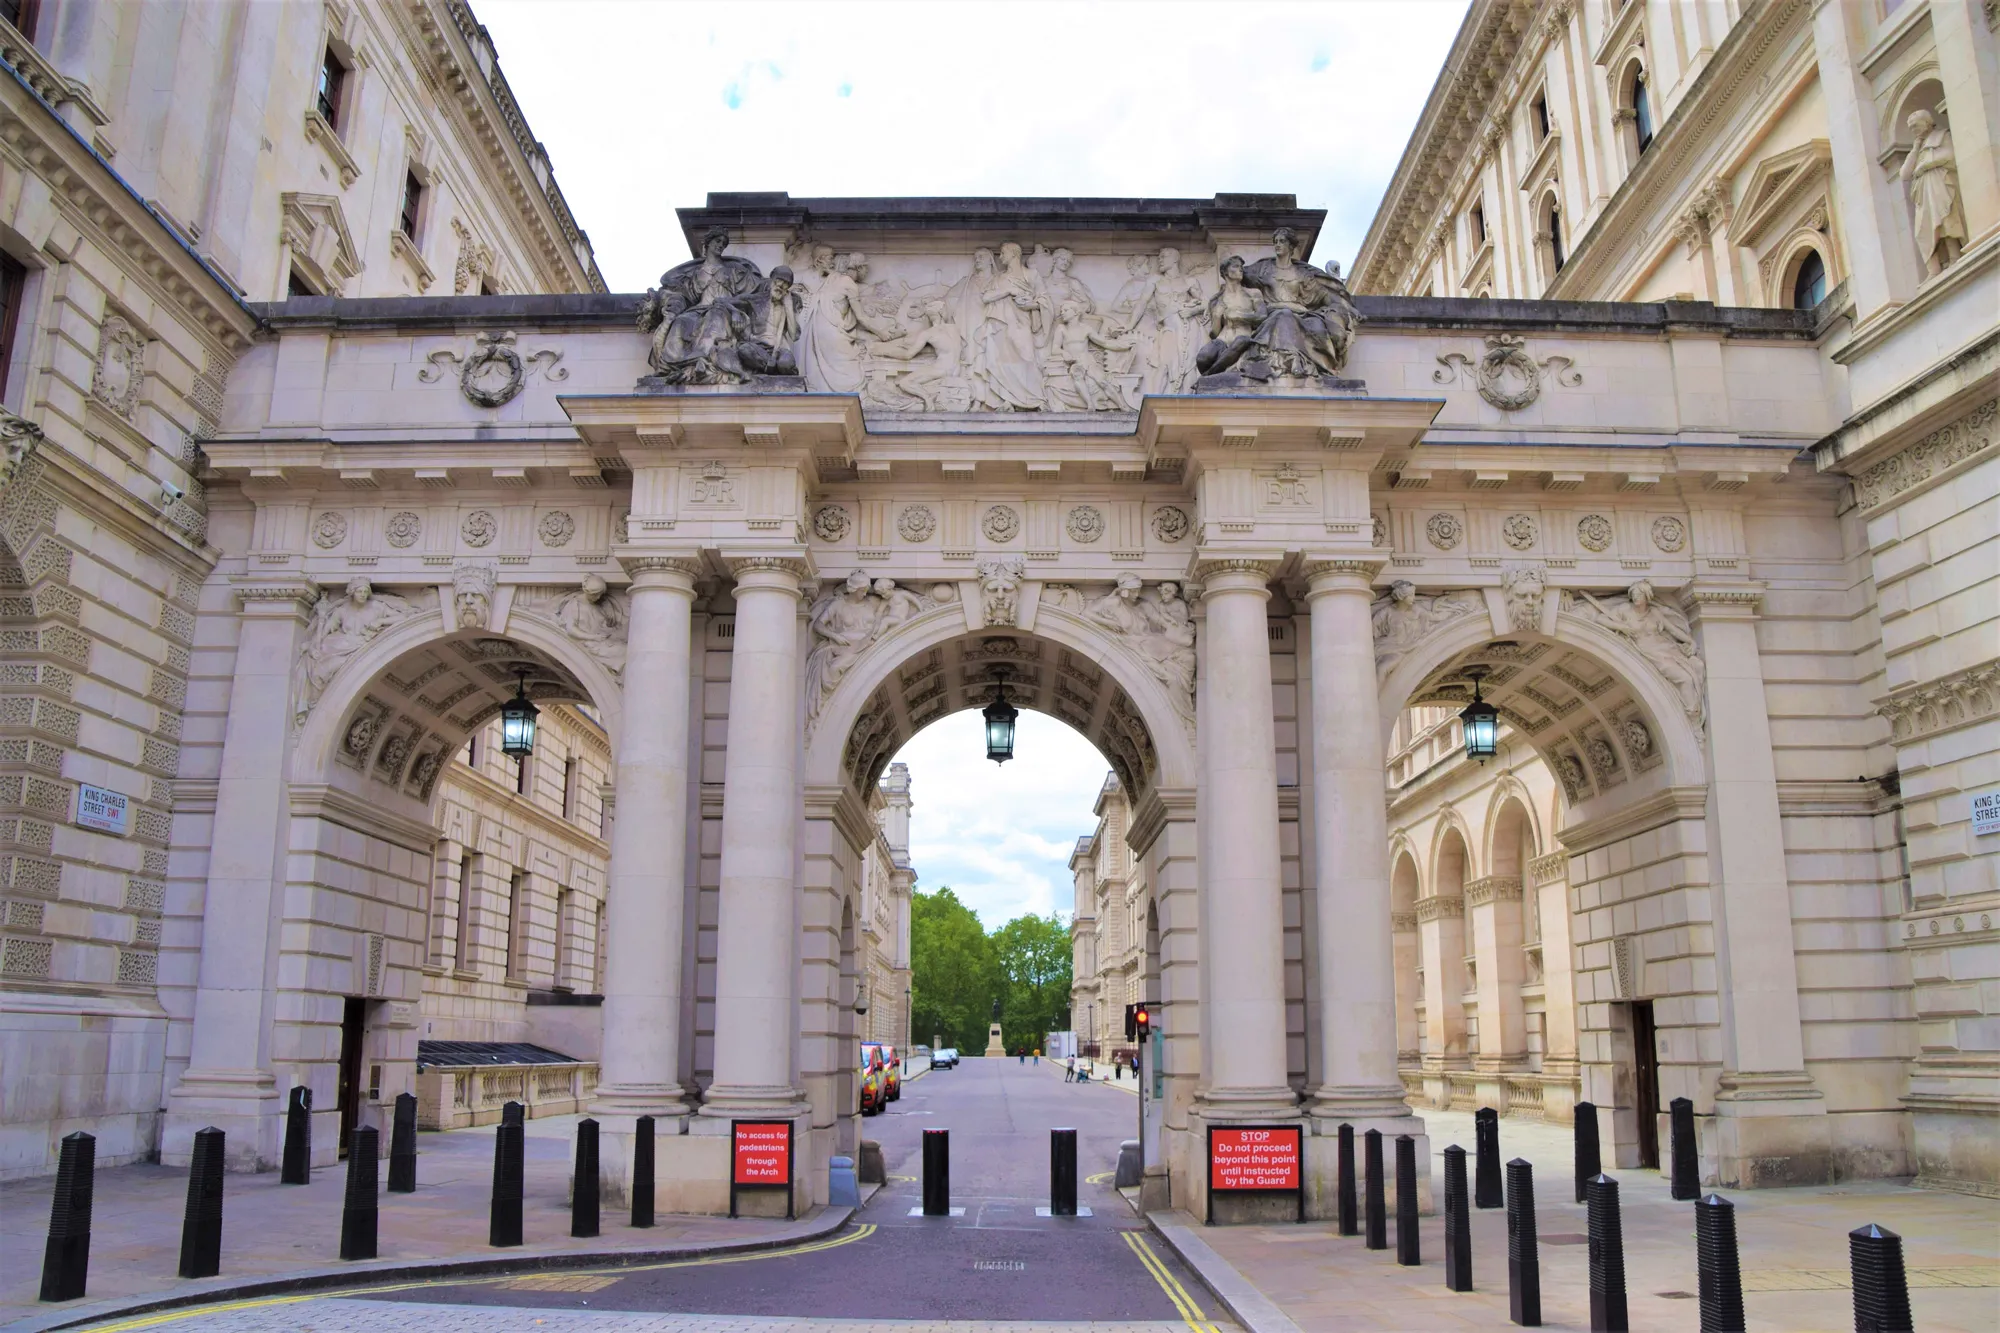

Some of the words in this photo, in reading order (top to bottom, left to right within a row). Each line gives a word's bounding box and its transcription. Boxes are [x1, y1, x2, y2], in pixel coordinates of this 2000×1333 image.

[85, 789, 99, 801] KING
[101, 794, 125, 808] CHARLES
[1974, 796, 1992, 808] KING
[84, 801, 104, 815] STREET
[107, 808, 119, 819] SW1
[1976, 807, 2000, 821] STREE
[1241, 1132, 1270, 1141] STOP
[740, 1144, 784, 1152] pedestrians
[1219, 1144, 1232, 1152] Do
[1235, 1144, 1250, 1152] not
[1253, 1144, 1292, 1154] proceed
[746, 1158, 778, 1166] through
[1215, 1156, 1250, 1166] beyond
[1272, 1155, 1296, 1165] point
[1220, 1167, 1240, 1175] until
[1244, 1167, 1290, 1175] instructed
[1226, 1177, 1236, 1186] by
[1257, 1176, 1286, 1184] Guard
